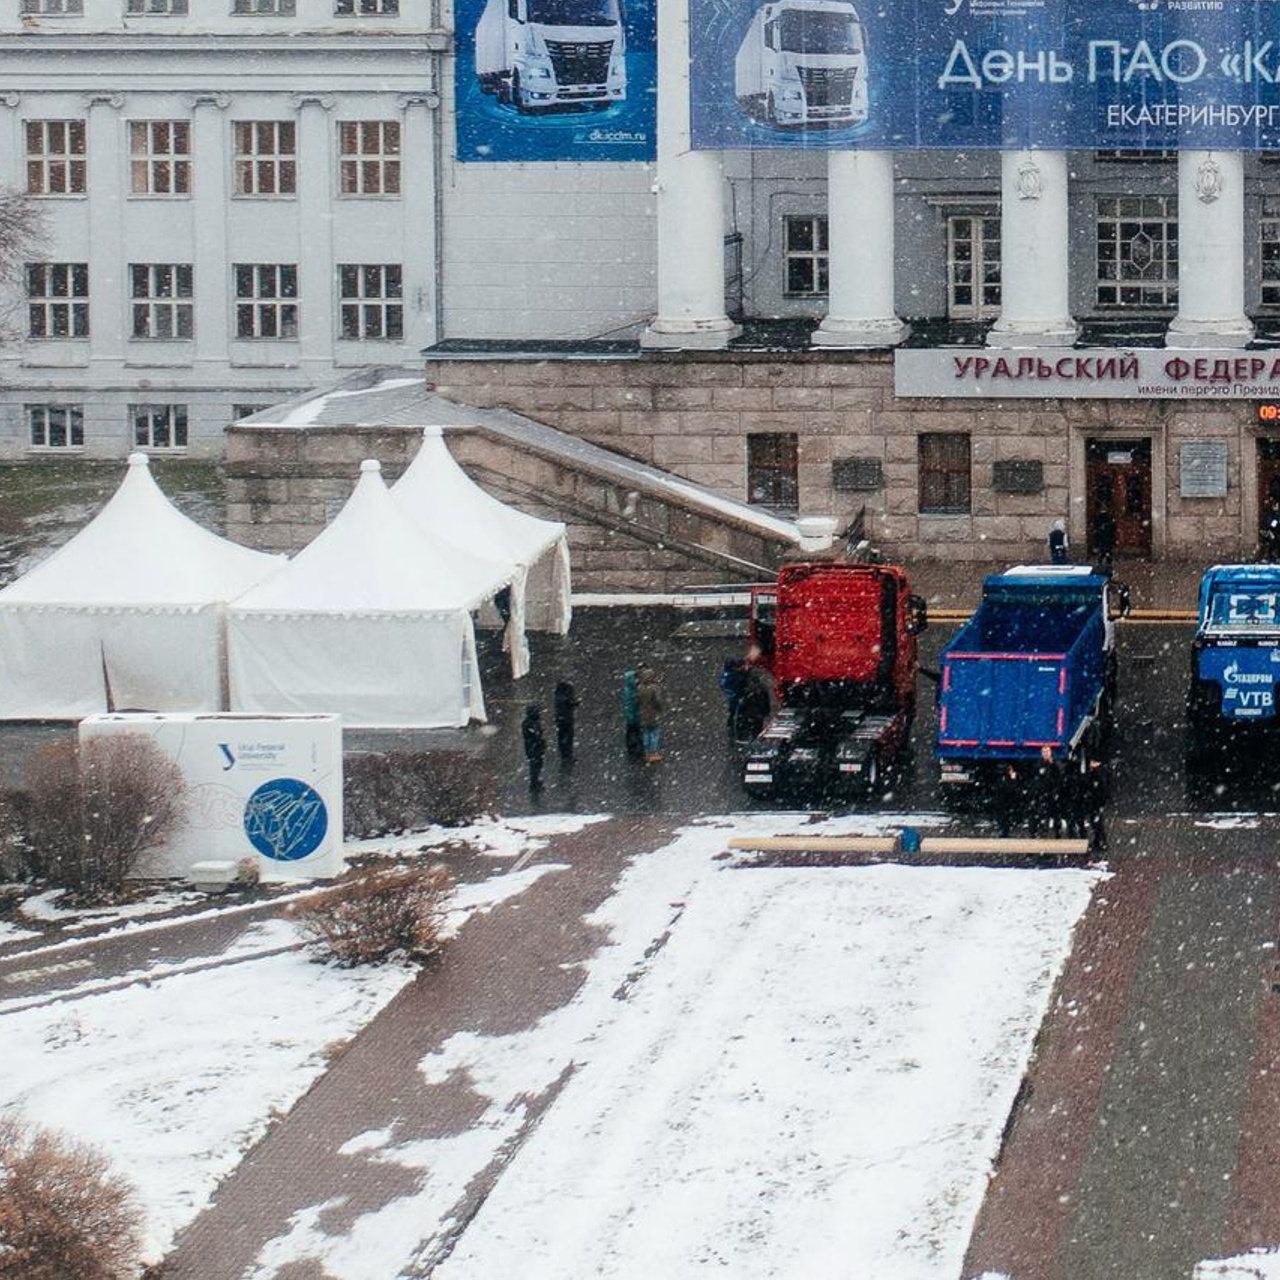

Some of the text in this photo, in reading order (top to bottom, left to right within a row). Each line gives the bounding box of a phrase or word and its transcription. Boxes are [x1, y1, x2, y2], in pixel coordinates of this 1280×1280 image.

[1167, 1, 1223, 11] РАЗВИТИЮ
[937, 39, 1074, 90] День
[1088, 39, 1208, 84] ПАО
[1106, 104, 1280, 127] ЕКАТЕРИНБУРГ
[954, 353, 1140, 380] УРАЛЬСКИЙ
[1137, 384, 1178, 395] имени
[1239, 691, 1273, 706] VTB
